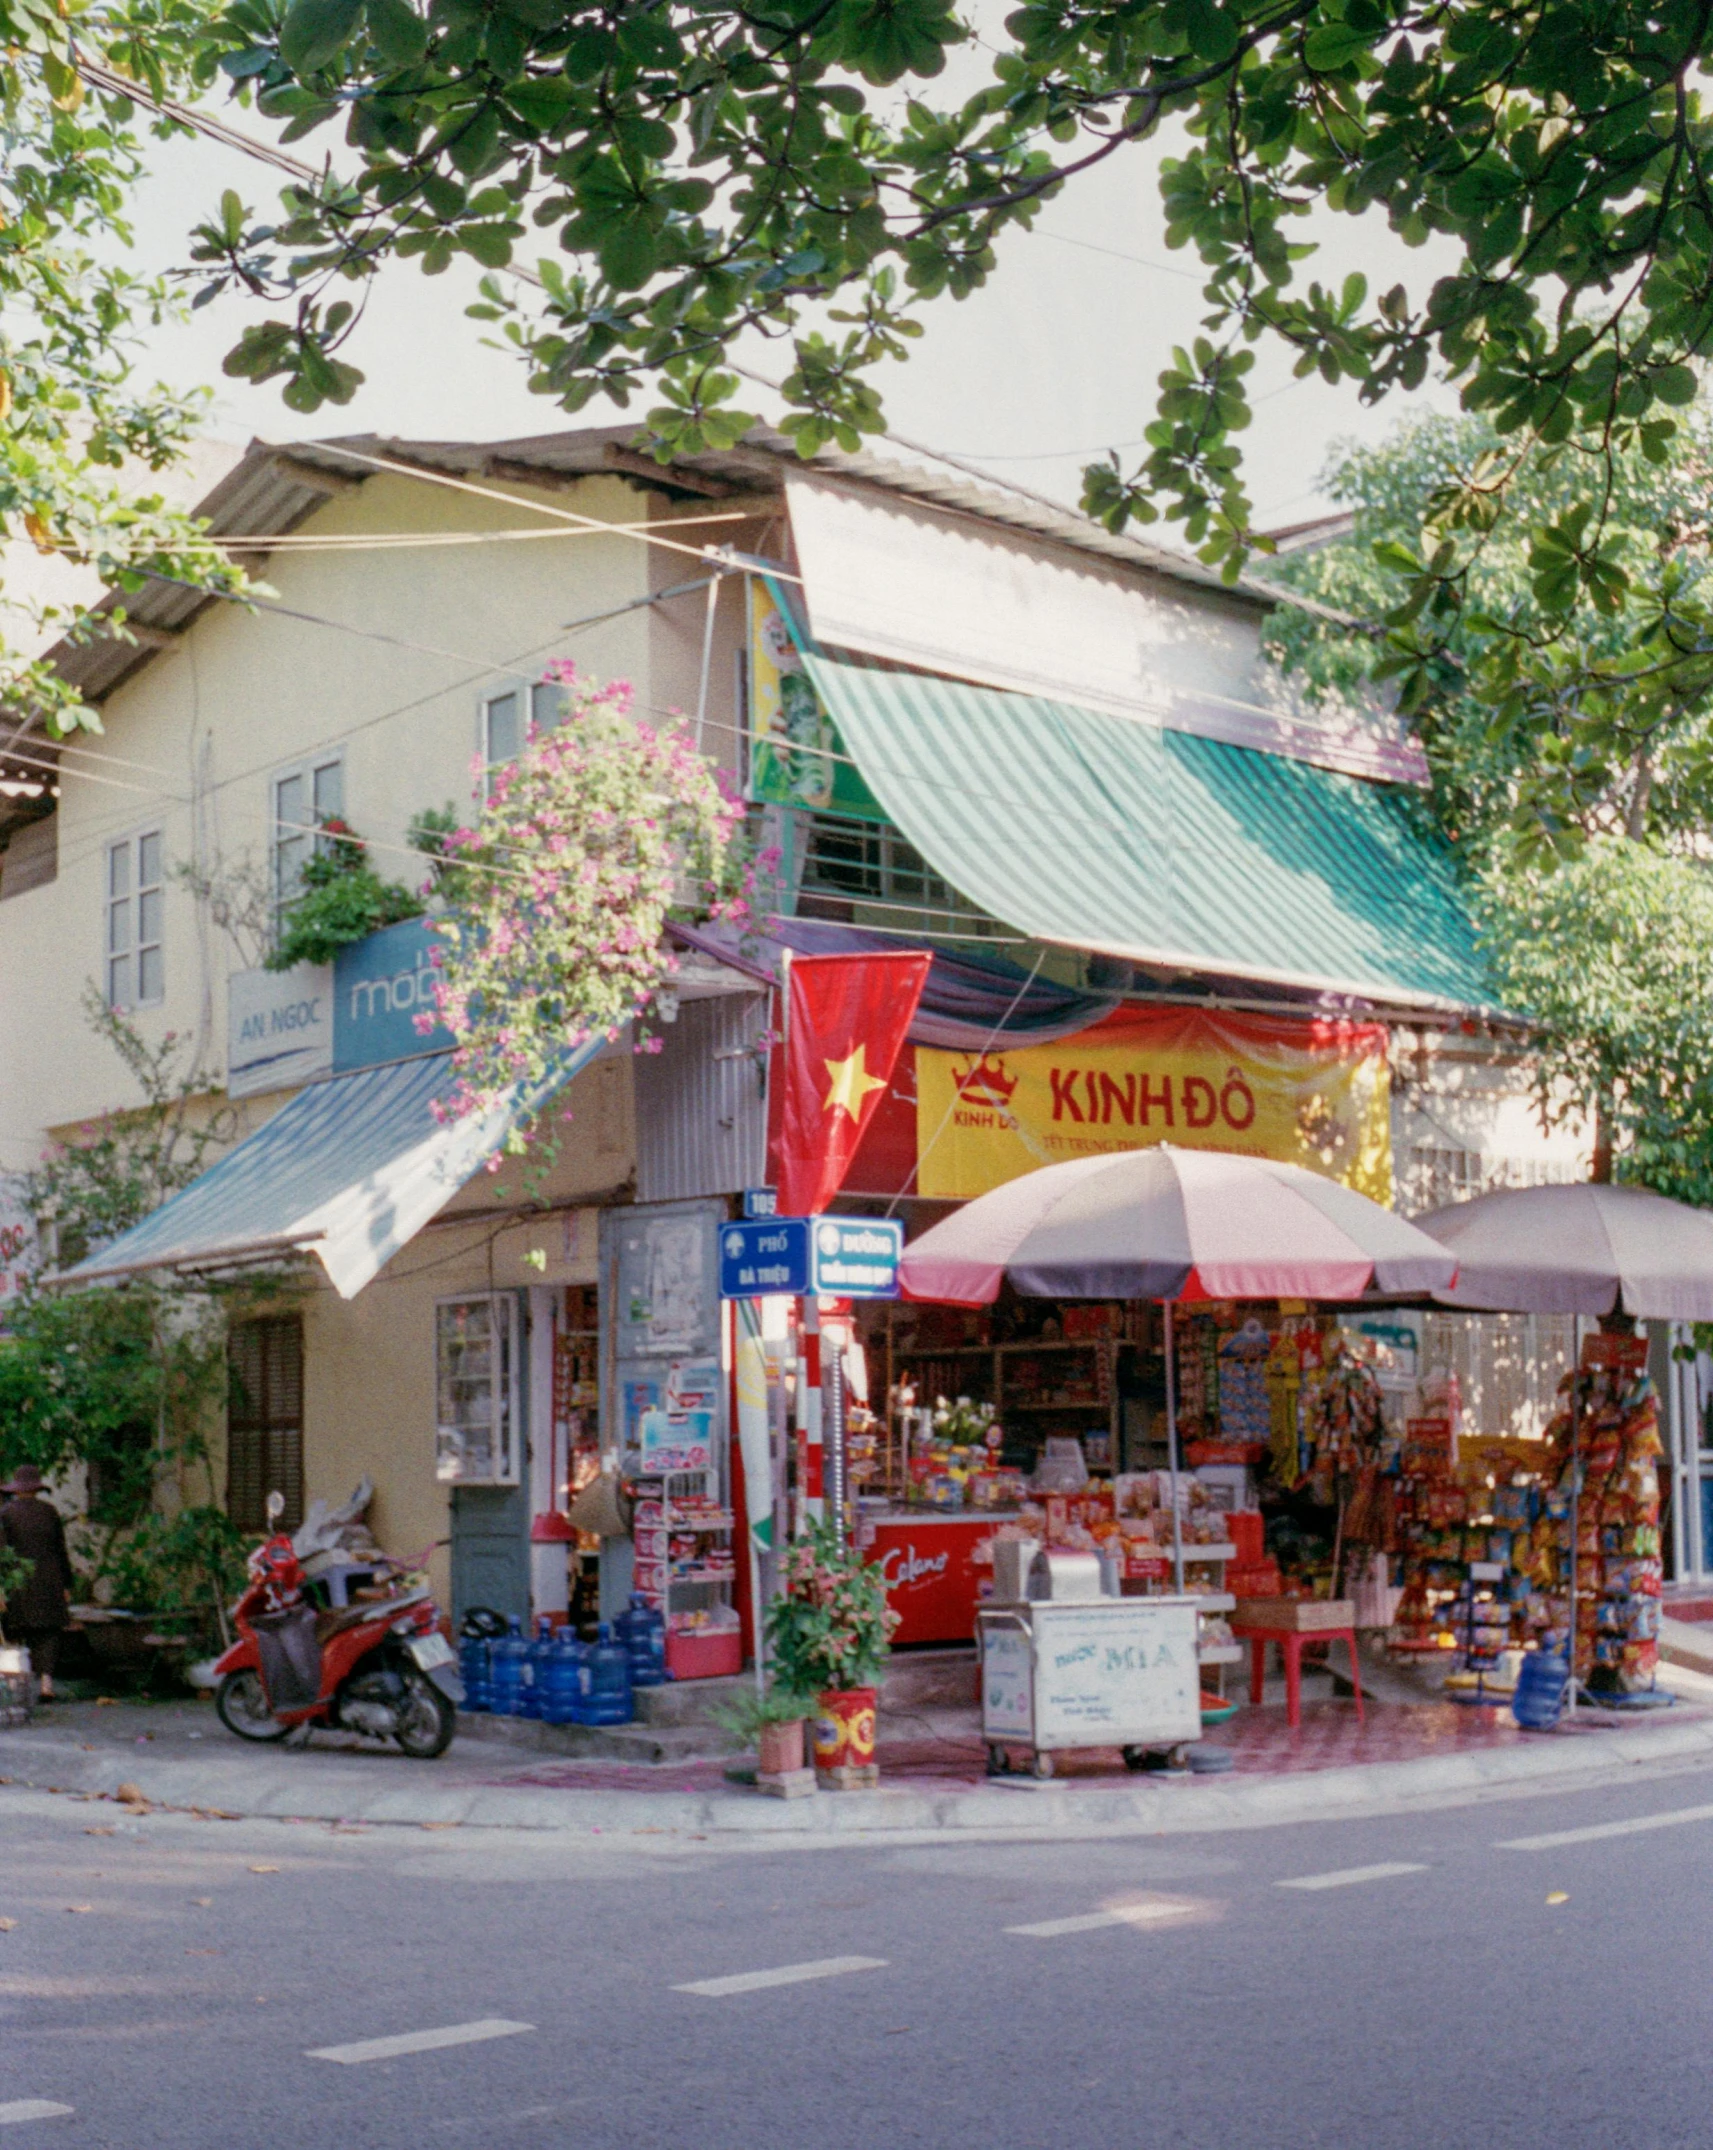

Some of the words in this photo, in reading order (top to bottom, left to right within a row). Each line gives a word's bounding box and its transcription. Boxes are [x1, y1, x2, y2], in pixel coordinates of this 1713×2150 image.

[239, 1013, 265, 1044] AN
[1051, 1067, 1175, 1127] KINH
[1181, 1065, 1256, 1131] ĐÔ
[954, 1110, 994, 1128] KINH
[758, 1228, 788, 1253] PHỐ
